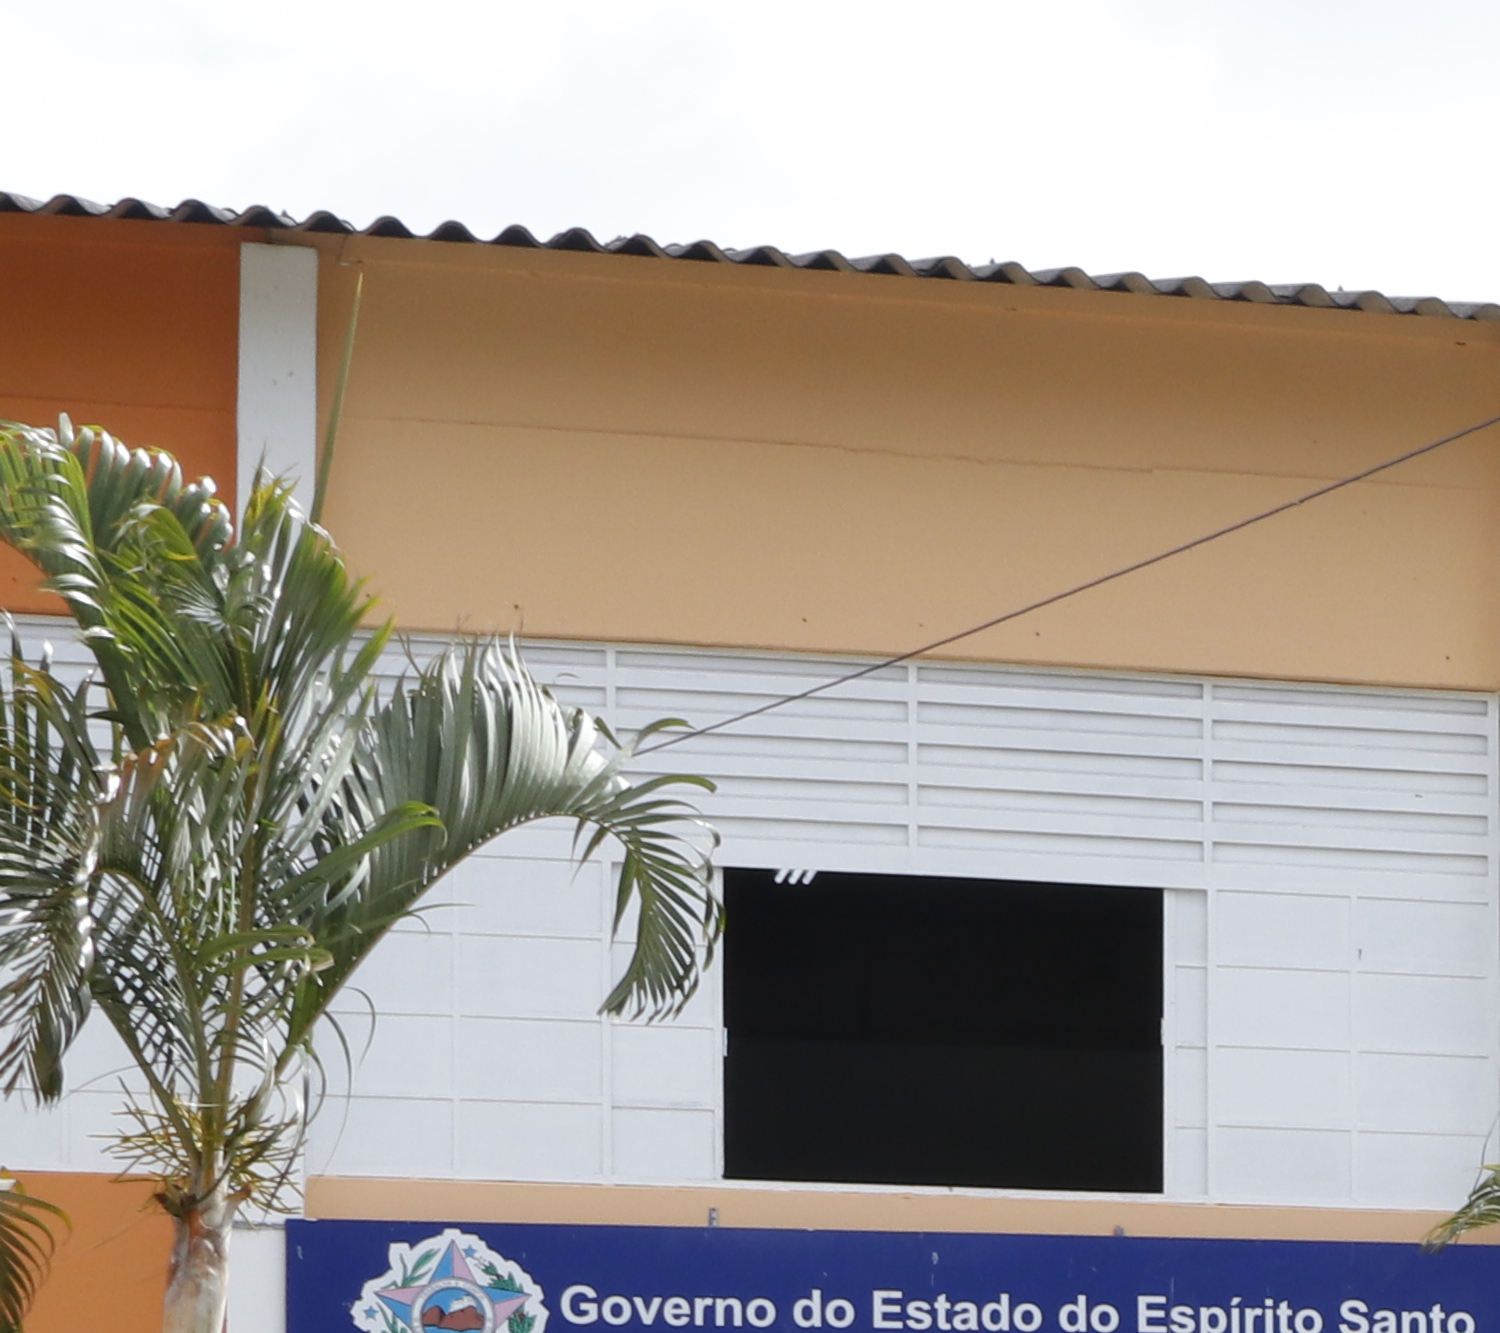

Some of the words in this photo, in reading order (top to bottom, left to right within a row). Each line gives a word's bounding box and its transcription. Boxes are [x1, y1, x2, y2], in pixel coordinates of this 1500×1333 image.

[560, 1284, 777, 1328] Governo
[792, 1289, 855, 1329] do
[872, 1289, 1043, 1333] Estado
[1058, 1294, 1120, 1333] do
